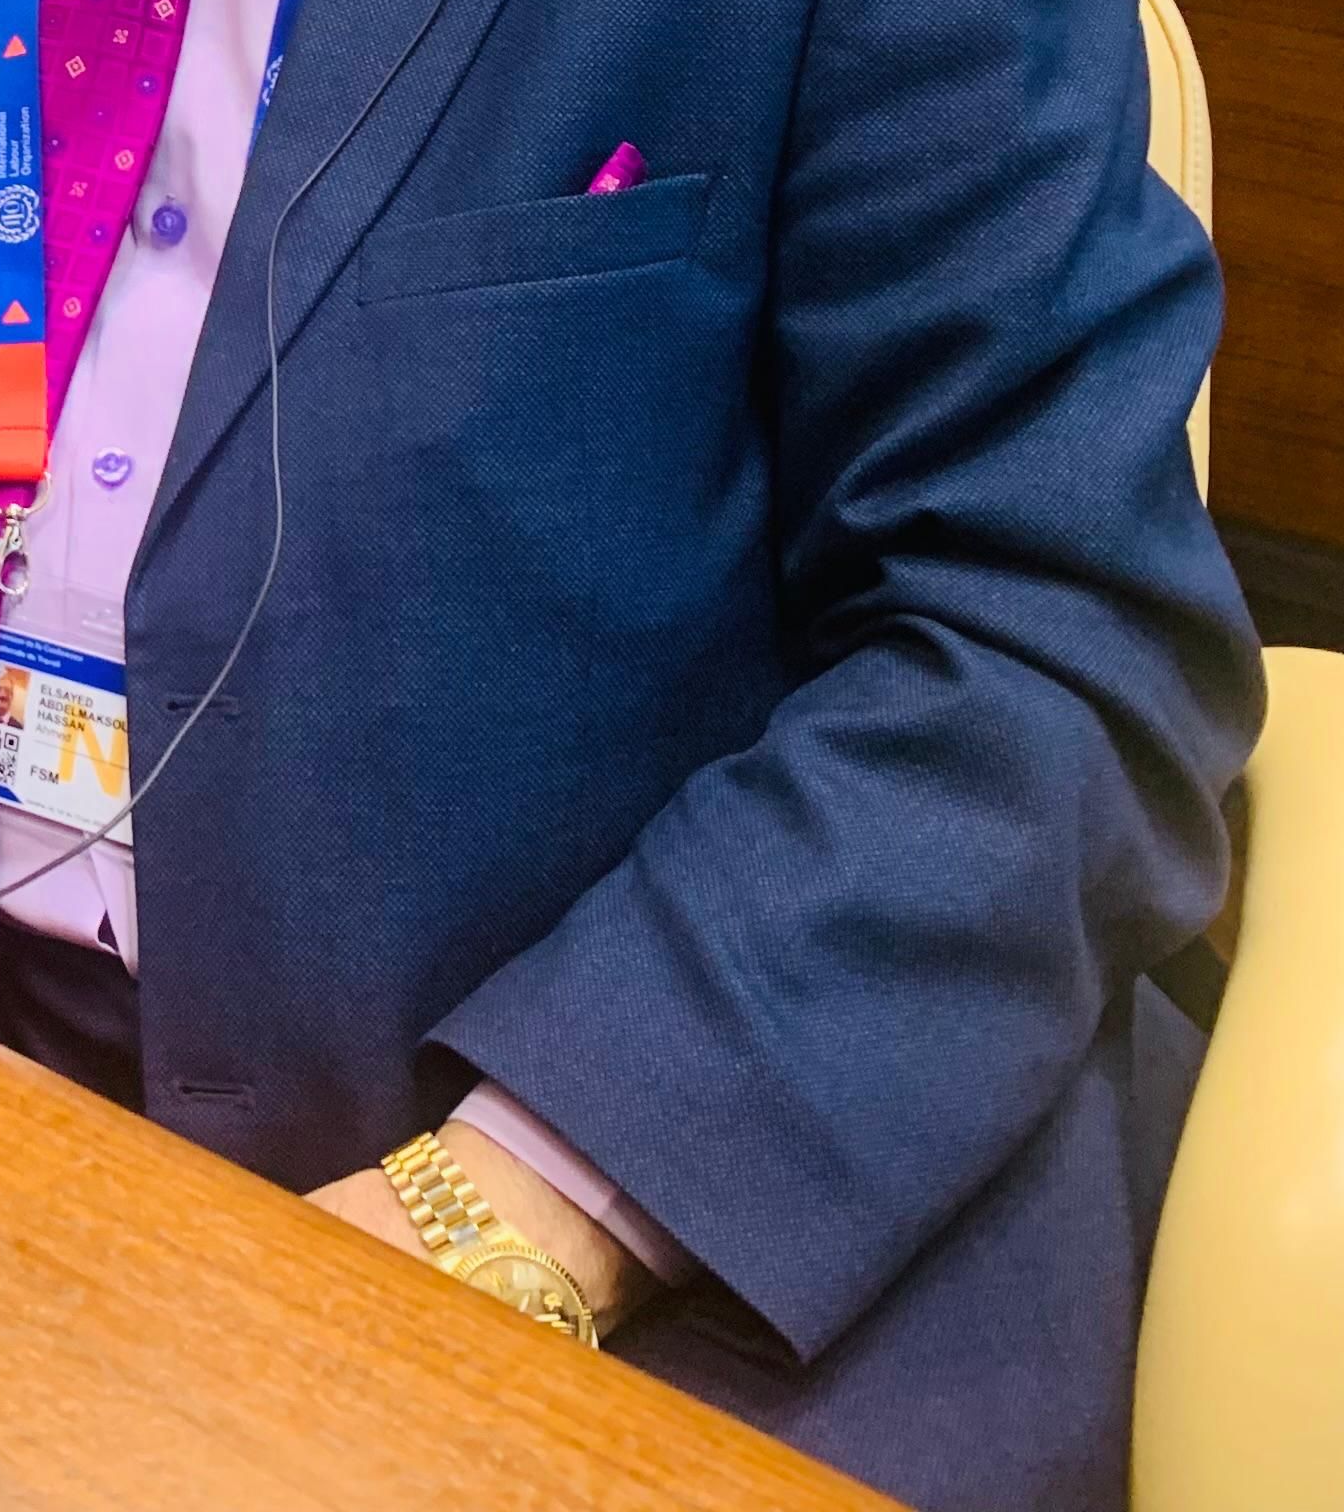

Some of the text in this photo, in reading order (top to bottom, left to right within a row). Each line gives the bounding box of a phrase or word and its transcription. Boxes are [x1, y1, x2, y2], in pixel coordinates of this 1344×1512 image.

[20, 106, 33, 176] Organization
[8, 139, 19, 178] Labour
[40, 683, 94, 708] ELSAYED
[37, 709, 86, 733] HASSAN
[30, 766, 60, 786] FSM
